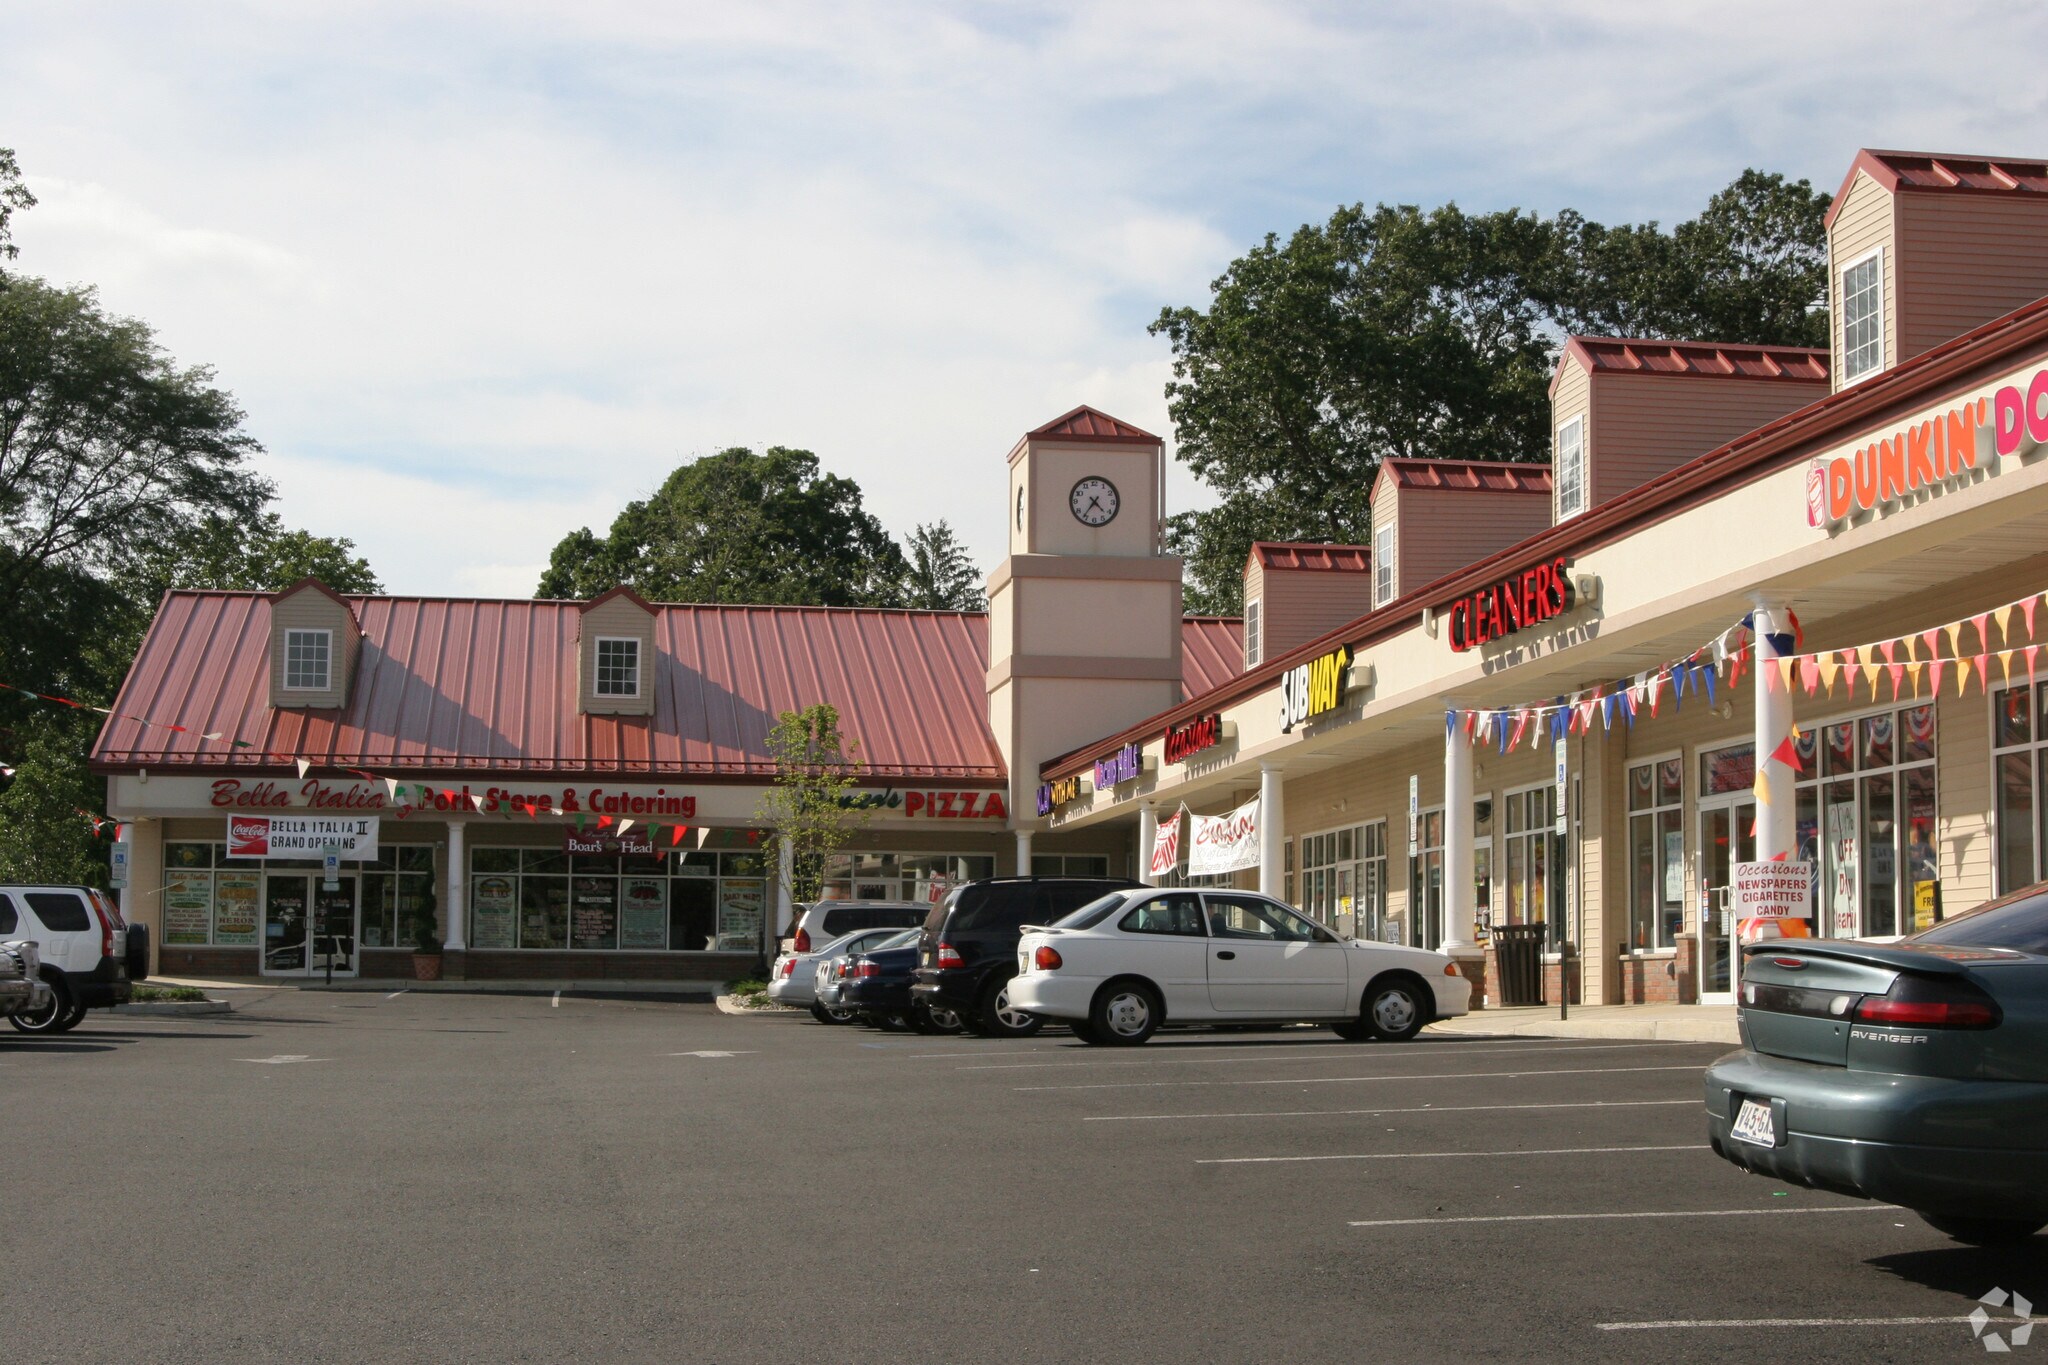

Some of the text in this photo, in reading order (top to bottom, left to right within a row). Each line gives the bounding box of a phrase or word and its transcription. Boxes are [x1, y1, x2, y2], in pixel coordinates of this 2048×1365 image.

[1829, 396, 1987, 521] DUNKIN'
[1448, 557, 1567, 652] CLEANERS
[1279, 645, 1347, 730] SUBWAY
[1117, 743, 1138, 783] NAILS
[210, 779, 386, 809] Bella Italia
[486, 787, 553, 812] Store
[562, 788, 580, 812] &
[589, 788, 697, 818] Catering
[905, 791, 1008, 819] PIZZA
[271, 820, 306, 833] BELLA
[313, 821, 354, 833] ITALIA
[271, 836, 356, 850] GRAND OPENING
[568, 838, 653, 853] Boar's Head
[1838, 838, 1853, 862] OFF
[1738, 863, 1807, 876] Occasions
[1738, 879, 1807, 890] NEWSPAPERS
[1742, 891, 1803, 903] CIGARETTES
[1756, 905, 1790, 916] CANDY
[1850, 1030, 1928, 1044] AVENGER
